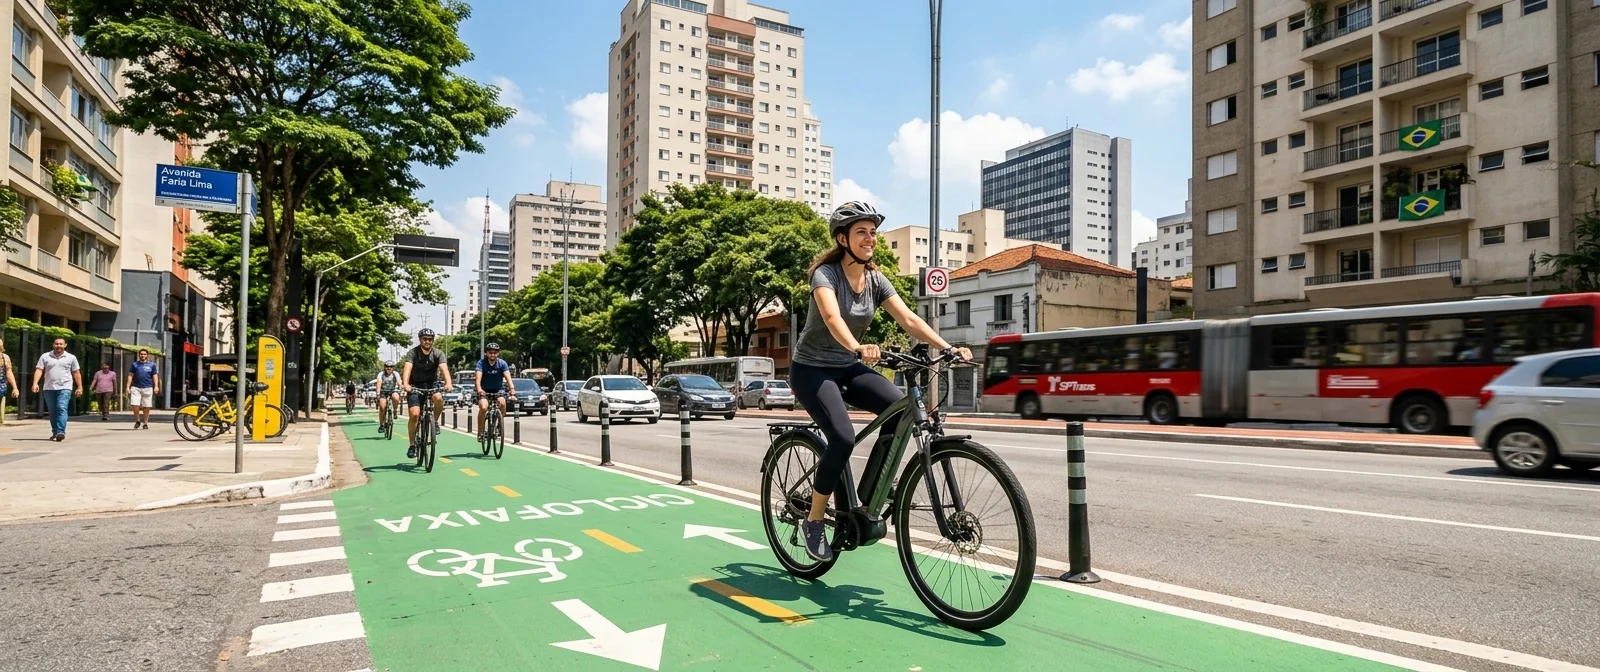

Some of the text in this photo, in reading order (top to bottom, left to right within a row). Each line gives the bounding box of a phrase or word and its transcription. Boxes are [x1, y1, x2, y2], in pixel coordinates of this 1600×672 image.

[161, 167, 201, 178] Avenida
[161, 176, 213, 189] Faria Lima
[374, 493, 695, 533] CICLOFAIXA
